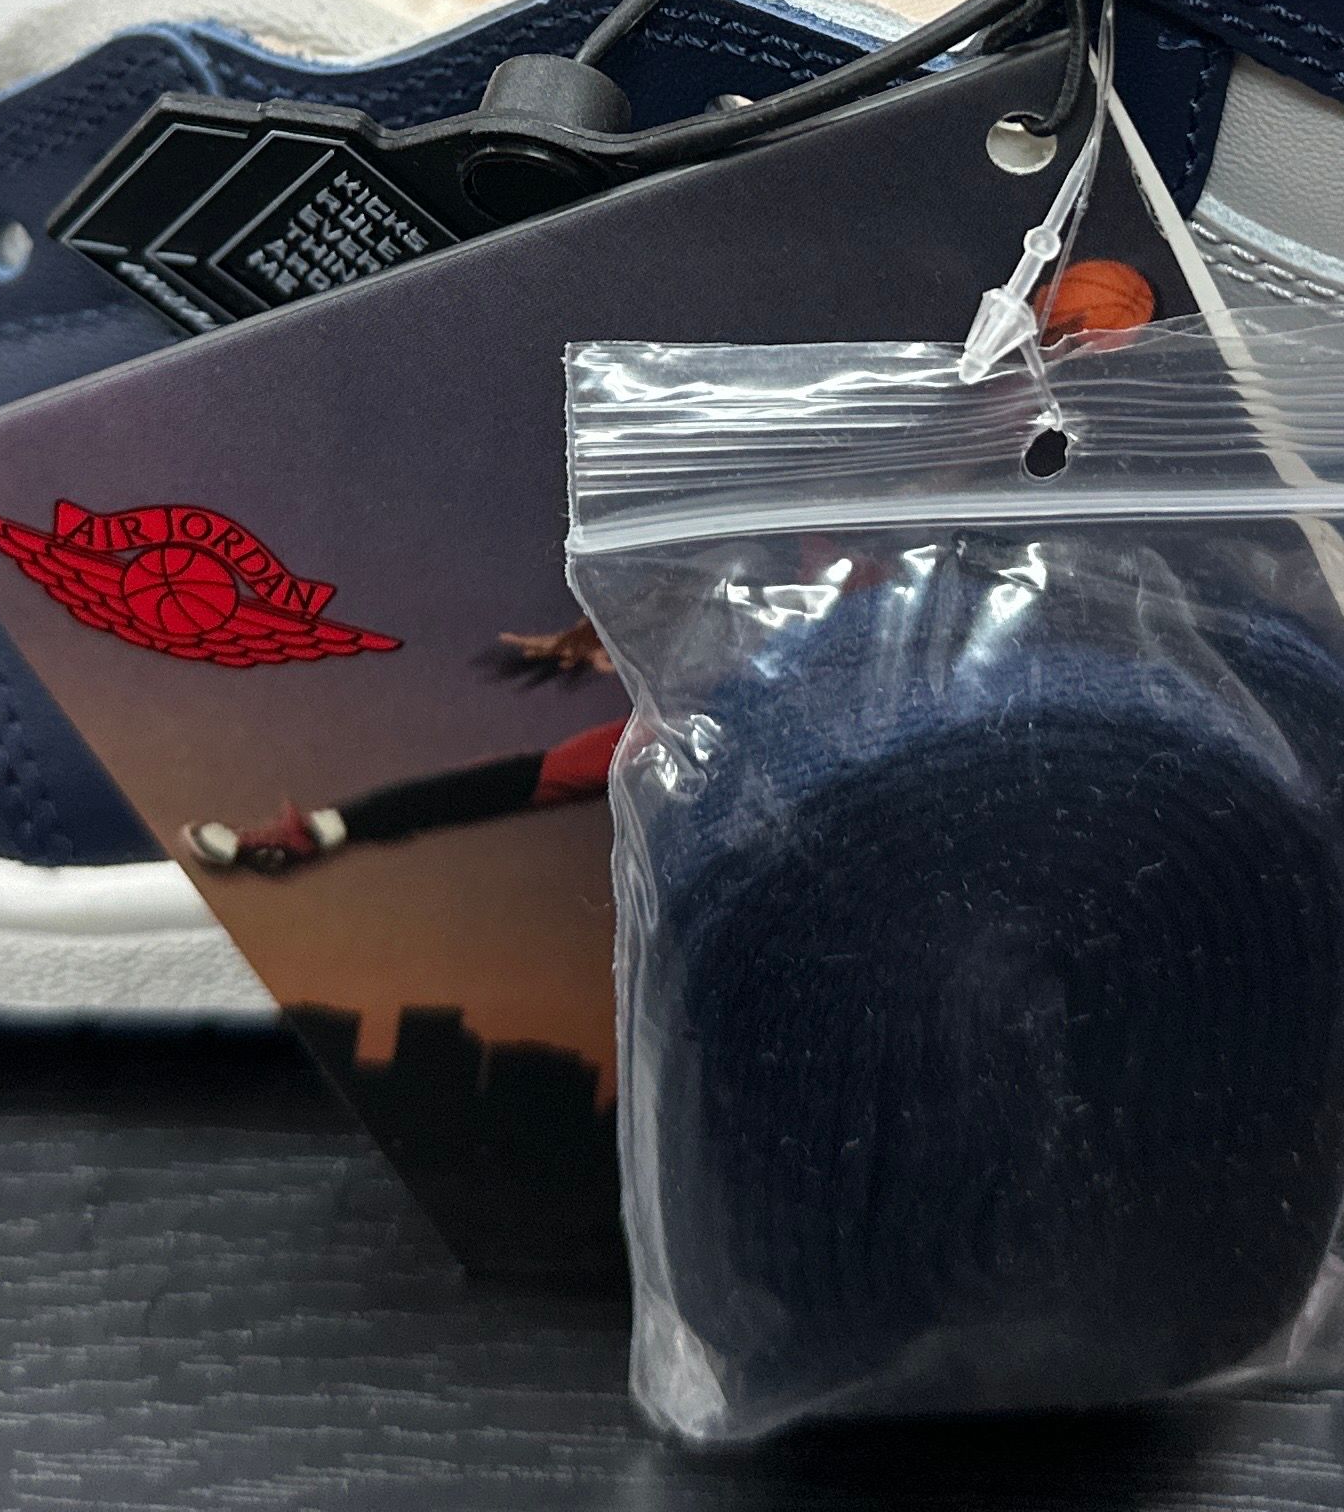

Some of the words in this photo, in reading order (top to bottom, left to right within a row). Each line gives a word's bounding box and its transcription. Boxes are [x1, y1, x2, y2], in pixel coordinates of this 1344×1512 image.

[298, 202, 389, 275] EVER
[315, 185, 403, 263] RULE
[333, 169, 430, 253] KICKS
[246, 248, 301, 296] ME
[263, 238, 340, 291] ARO
[286, 216, 359, 283] THIN
[64, 512, 150, 549] AIR
[161, 506, 322, 618] JORDAN
